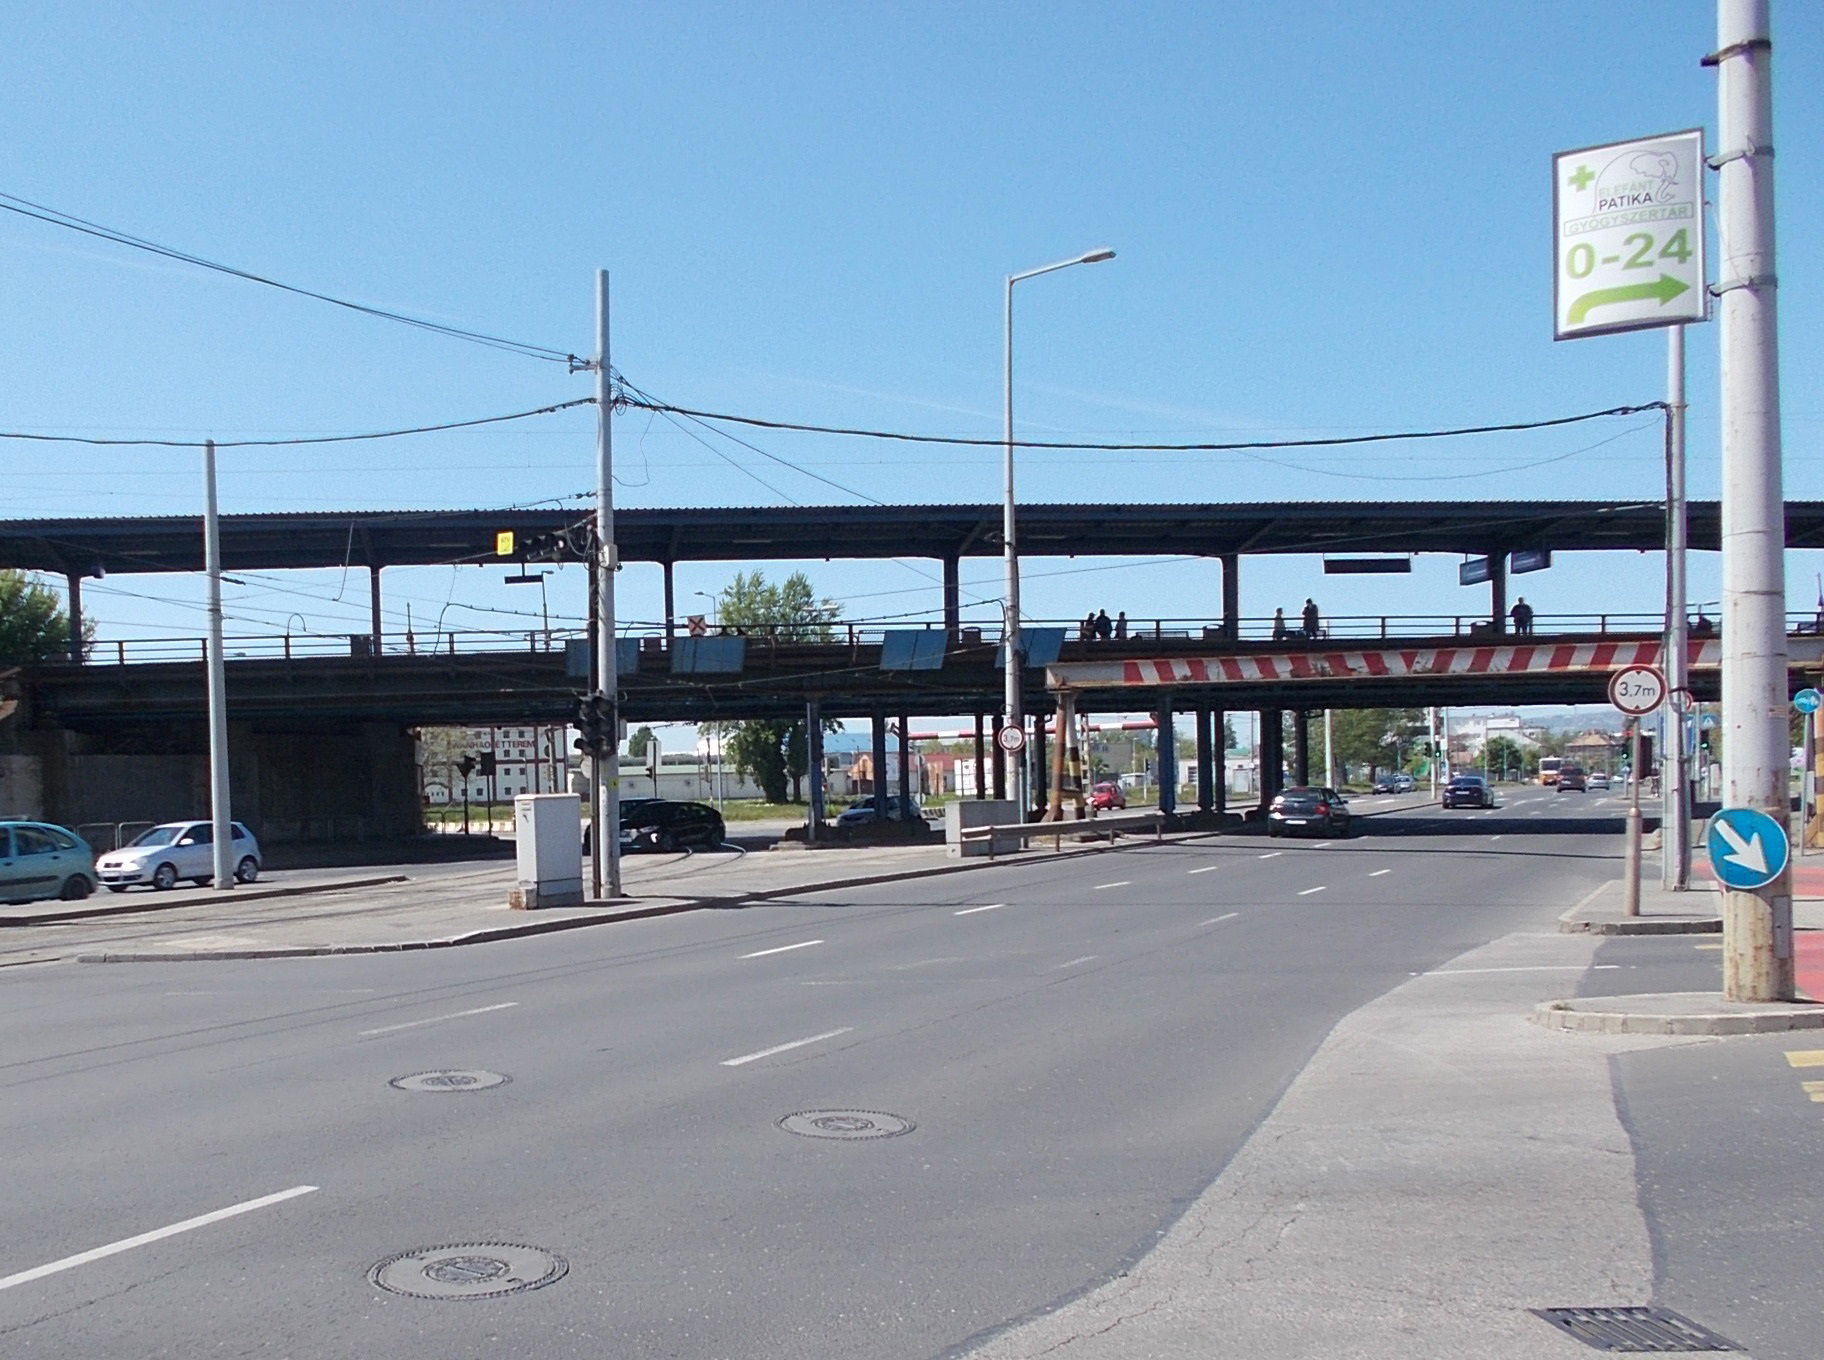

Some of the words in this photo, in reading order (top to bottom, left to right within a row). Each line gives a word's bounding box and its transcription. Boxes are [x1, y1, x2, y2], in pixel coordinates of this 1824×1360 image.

[1599, 180, 1655, 198] ELEFANT
[1599, 192, 1653, 211] PATIKA
[1566, 228, 1693, 280] 0-24
[1619, 681, 1656, 697] 3.7m
